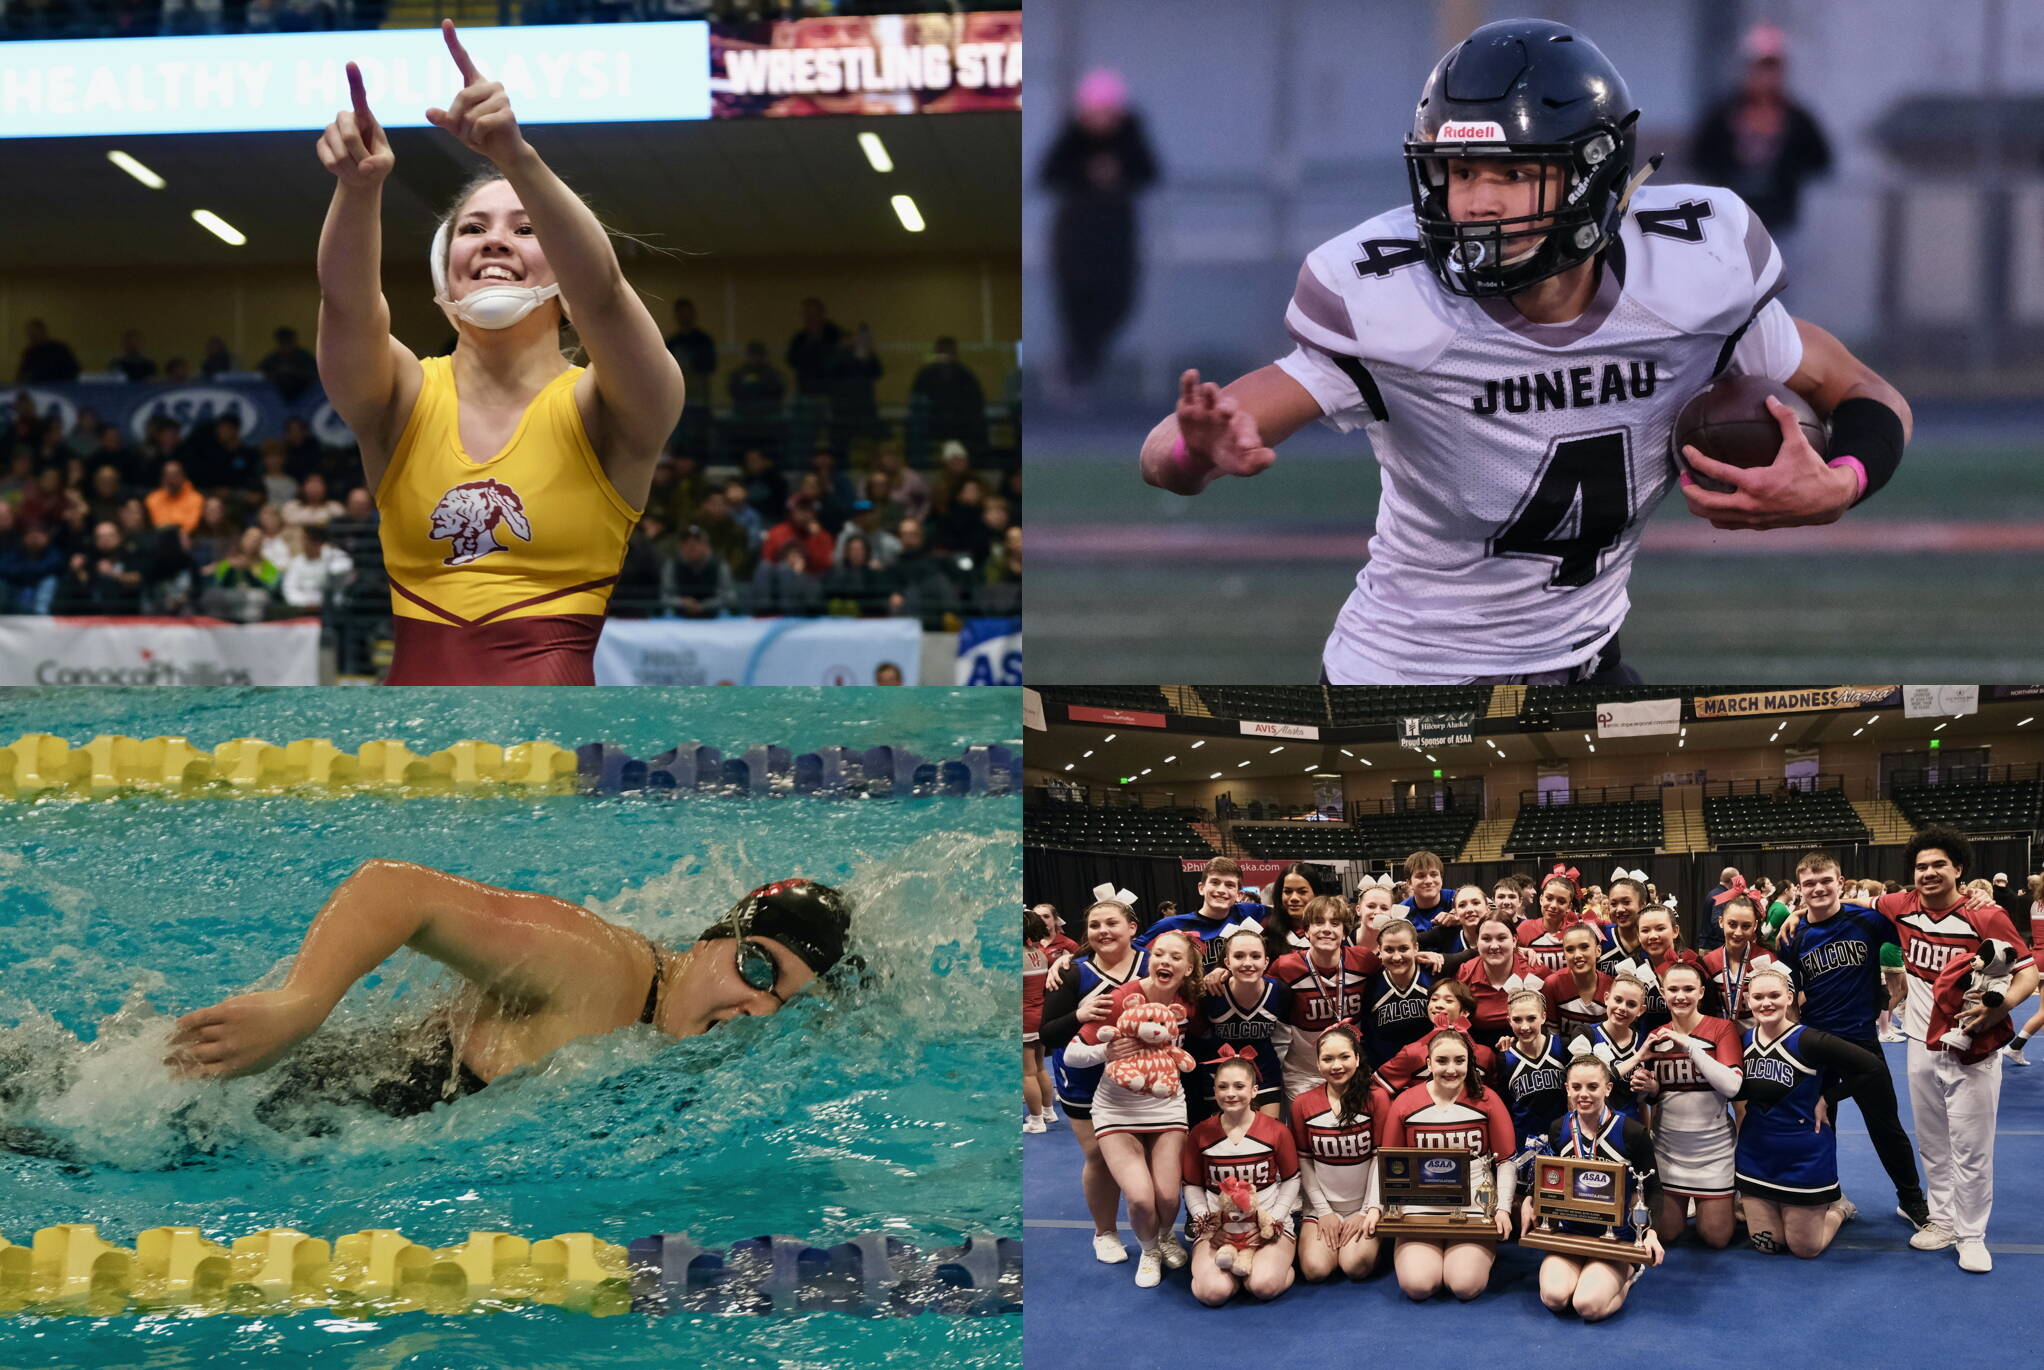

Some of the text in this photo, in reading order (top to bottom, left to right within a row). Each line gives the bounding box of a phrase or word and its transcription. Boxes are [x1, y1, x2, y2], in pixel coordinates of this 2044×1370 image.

[3, 49, 634, 114] HEALTHY HOLIAYS!
[724, 44, 952, 95] WRESTLING
[1443, 125, 1495, 138] Riddell
[1632, 196, 1716, 245] 4
[1353, 237, 1424, 279] 4
[1471, 360, 1657, 415] JUNEAU
[1485, 425, 1637, 592] 4
[1704, 697, 1759, 714] MARCH
[1764, 690, 1839, 710] MADNESS
[1834, 687, 1892, 705] Alaska
[1255, 724, 1277, 734] AVIS
[1447, 720, 1469, 728] Alaska
[1401, 733, 1473, 747] Proud Sponsor of ASAA
[1802, 939, 1868, 981] FALCONS
[1312, 1130, 1371, 1158] JDHS
[1208, 1160, 1270, 1185] JDHS
[1428, 1160, 1453, 1169] ASAA
[1582, 1172, 1607, 1183] ASAA
